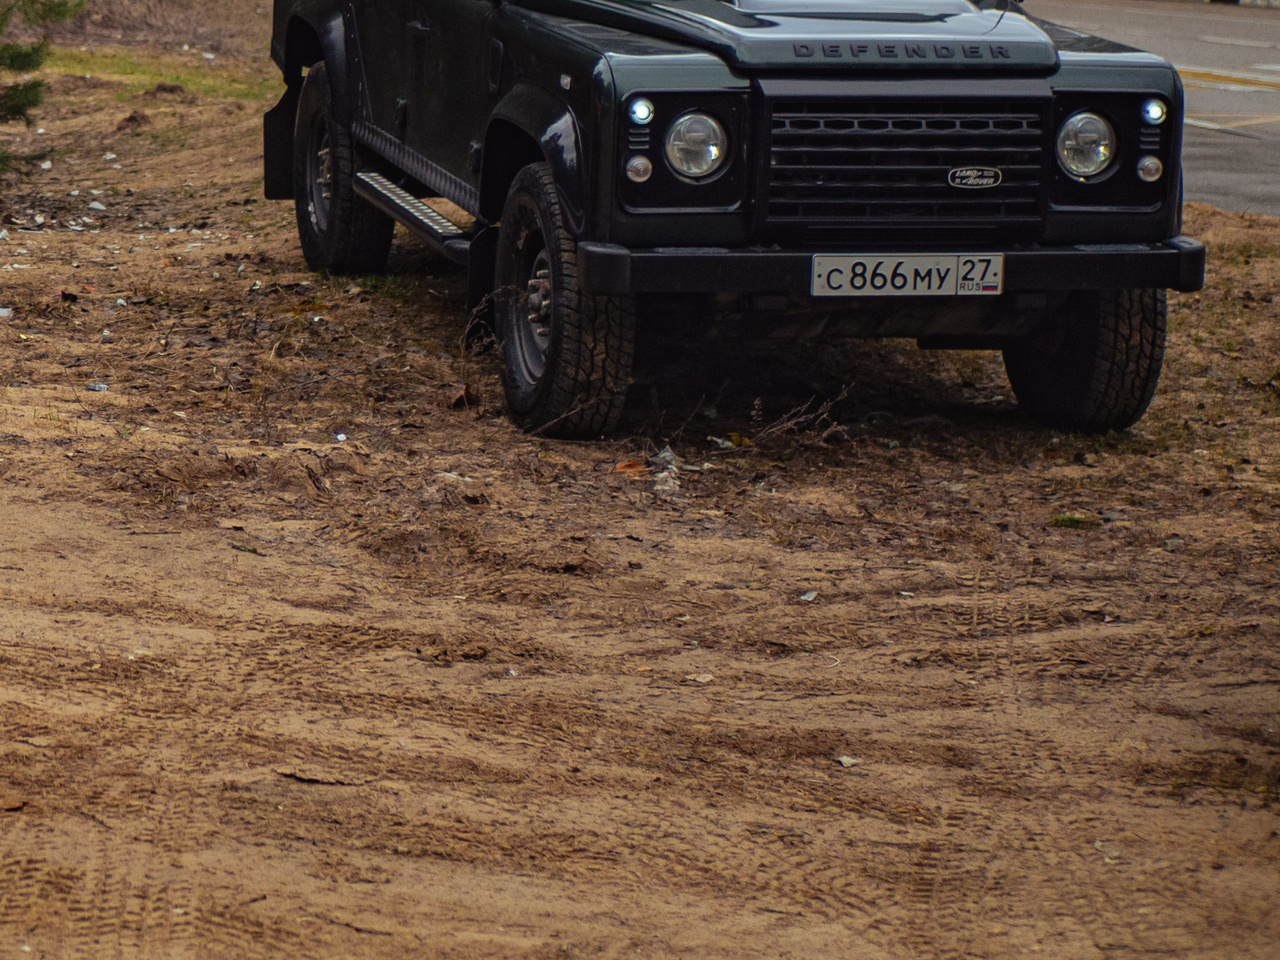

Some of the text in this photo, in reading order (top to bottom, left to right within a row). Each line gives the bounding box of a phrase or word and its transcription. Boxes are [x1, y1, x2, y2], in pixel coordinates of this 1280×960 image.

[793, 43, 1011, 59] DEFENDER
[955, 169, 978, 177] LAND
[961, 258, 992, 281] 27
[959, 282, 981, 291] RUS
